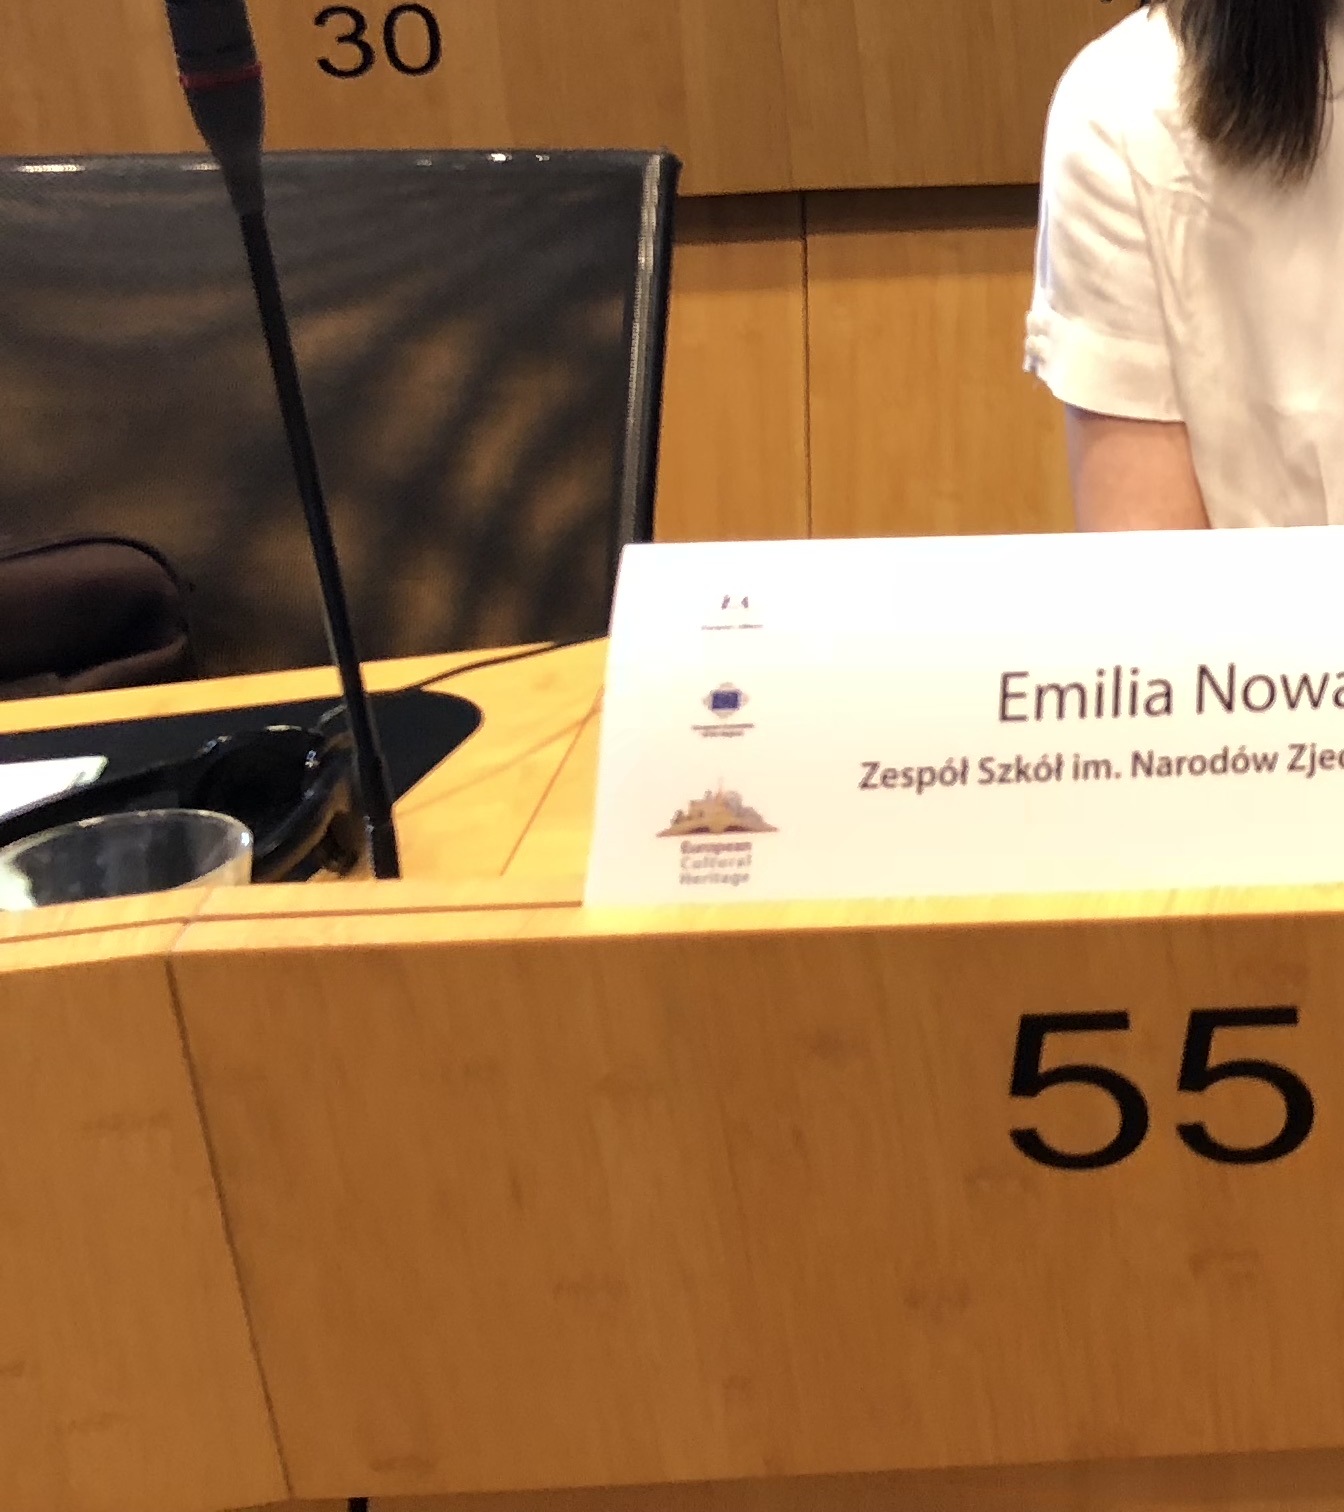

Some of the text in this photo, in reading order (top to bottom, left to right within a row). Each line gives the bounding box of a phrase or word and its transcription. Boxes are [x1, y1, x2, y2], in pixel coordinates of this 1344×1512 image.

[314, 2, 443, 79] 30
[997, 663, 1175, 726] Emilia
[858, 756, 971, 796] Zespół
[977, 752, 1065, 786] Szkół
[1071, 753, 1122, 782] im.
[1130, 744, 1280, 780] Narodów
[681, 854, 752, 869] Cultural
[1010, 1005, 1315, 1171] 55
